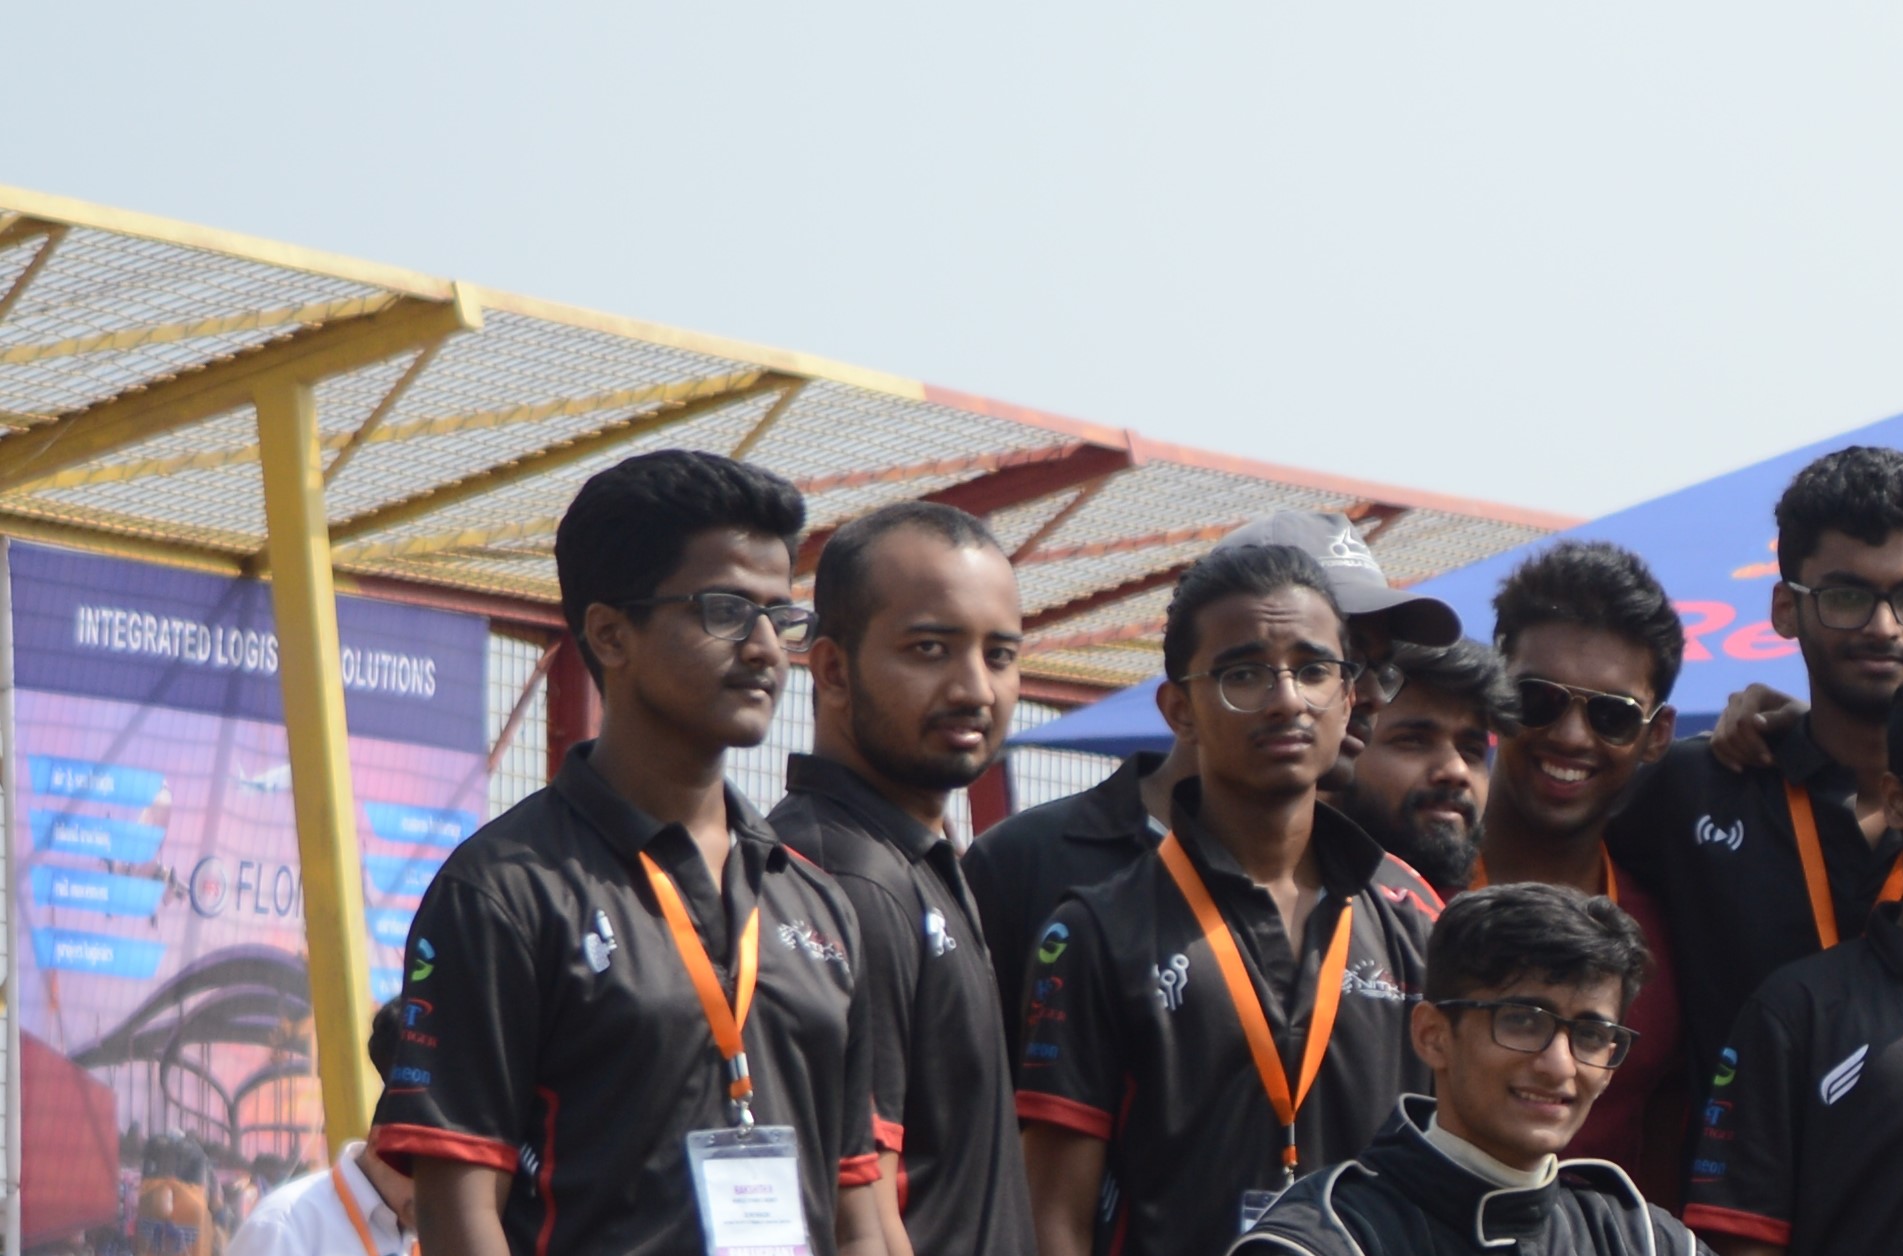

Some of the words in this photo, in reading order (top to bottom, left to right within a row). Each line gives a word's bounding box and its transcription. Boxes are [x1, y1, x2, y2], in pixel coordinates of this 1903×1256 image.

[77, 606, 211, 663] INTEGRATED
[214, 624, 279, 674] LOGIS
[342, 646, 436, 698] OLUTIONS
